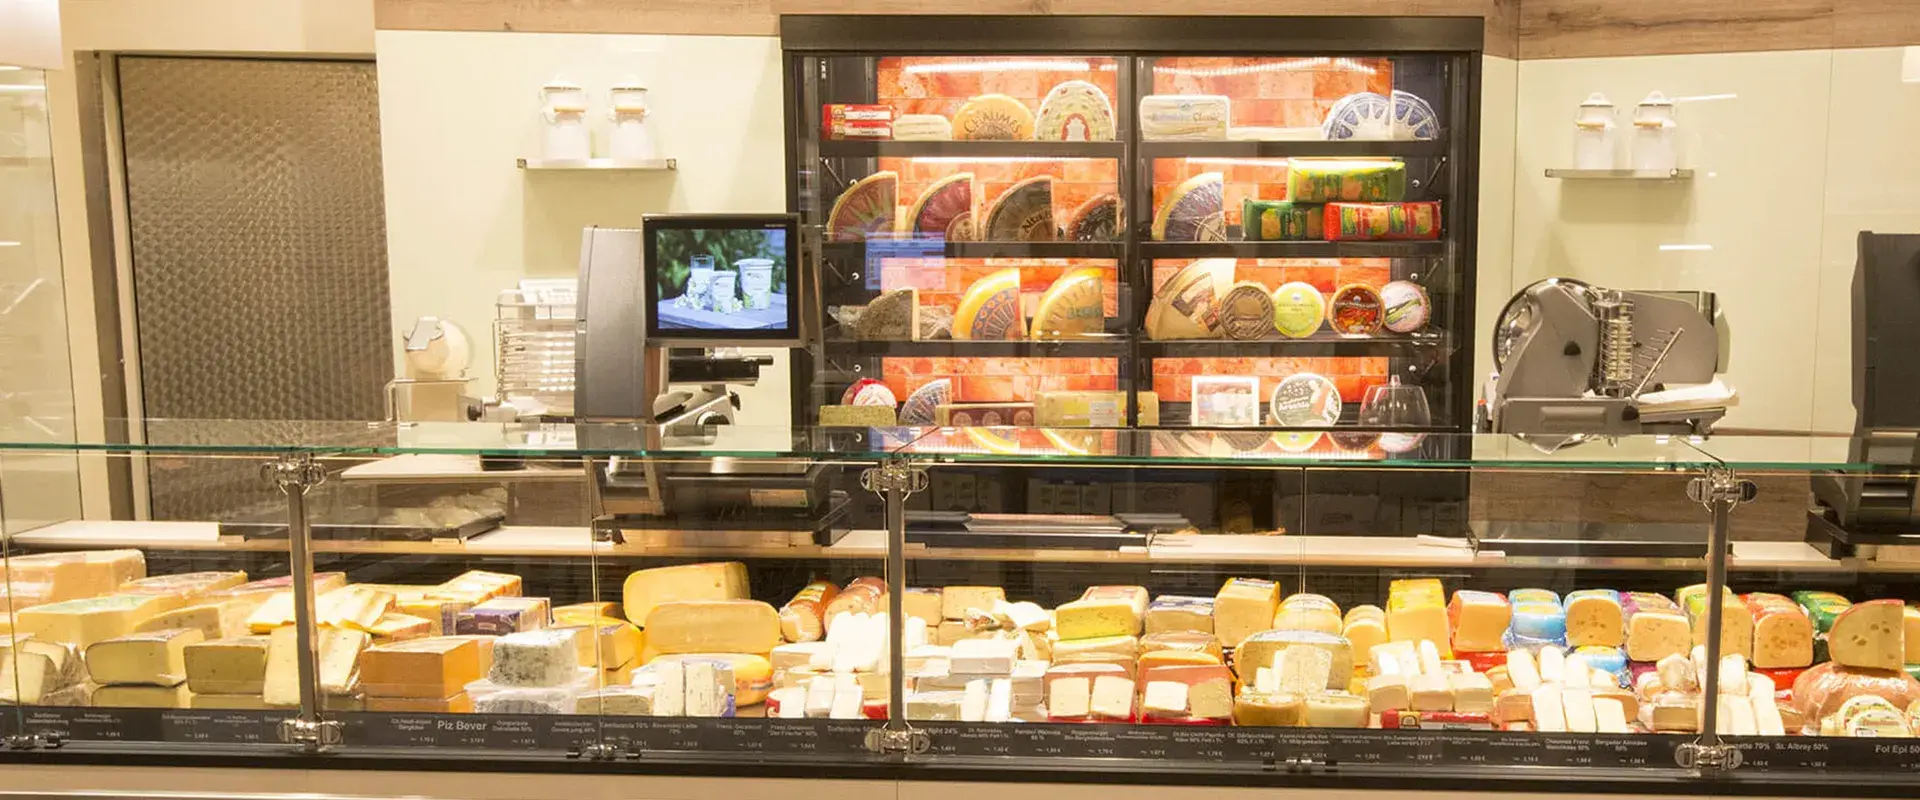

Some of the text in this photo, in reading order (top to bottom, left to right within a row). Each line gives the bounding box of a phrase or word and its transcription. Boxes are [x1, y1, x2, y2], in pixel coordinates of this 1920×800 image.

[437, 720, 454, 730] Piz
[1875, 744, 1890, 753] Fol
[1892, 744, 1908, 754] Epi
